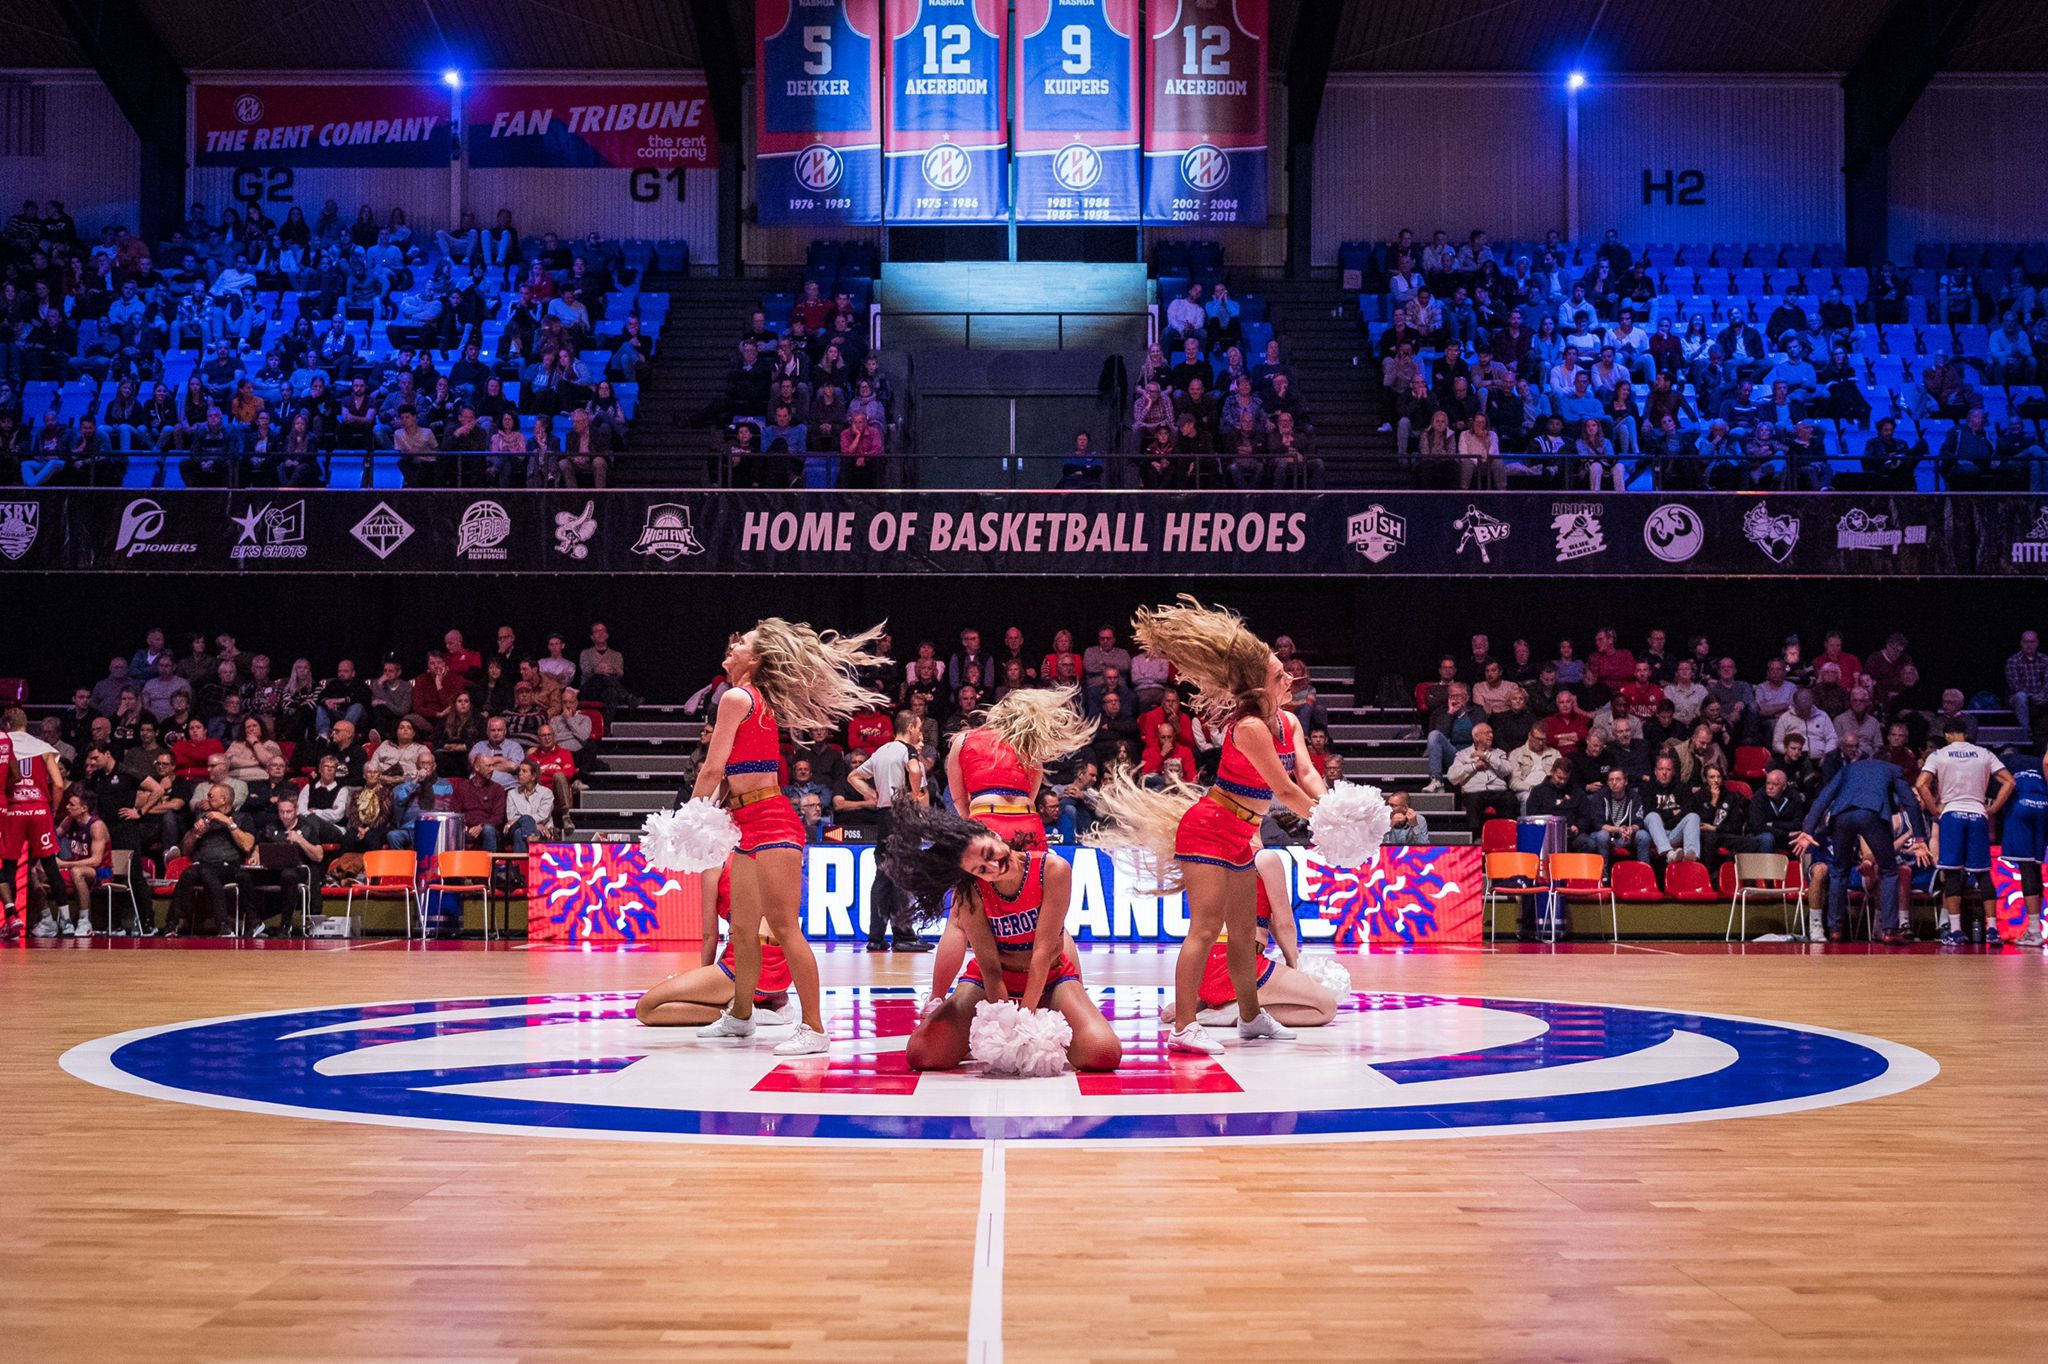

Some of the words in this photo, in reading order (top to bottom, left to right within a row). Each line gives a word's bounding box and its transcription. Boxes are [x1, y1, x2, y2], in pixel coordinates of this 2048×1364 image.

[804, 26, 832, 75] 5
[923, 24, 971, 74] 12
[1061, 24, 1091, 75] 9
[1182, 25, 1230, 75] 12
[786, 79, 850, 96] DEKKER
[905, 78, 988, 95] AKERBOOM
[1044, 79, 1109, 95] KUIPERS
[1164, 79, 1247, 96] AKERBOOM
[490, 109, 554, 138] FAN
[567, 98, 706, 133] TRIBUNE
[206, 130, 249, 152] THE
[253, 125, 314, 151] RENT
[318, 116, 439, 147] COMPANY
[648, 134, 673, 148] the
[676, 135, 707, 148] rent
[637, 147, 707, 162] company
[233, 167, 294, 203] G2
[630, 167, 686, 203] G1
[1643, 169, 1705, 205] H2
[789, 199, 814, 210] 1976
[825, 198, 851, 209] 1983
[916, 198, 941, 209] 1975
[953, 198, 979, 209] 1986
[1047, 197, 1072, 208] 1981
[1084, 197, 1110, 208] 1984
[1172, 199, 1200, 209] 2002
[1210, 199, 1238, 210] 2004
[1172, 210, 1200, 221] 2006
[1210, 211, 1236, 222] 2018
[361, 525, 404, 536] ALMONTE
[741, 511, 855, 552] HOME
[869, 511, 918, 552] OF
[930, 511, 1148, 553] BASKETBALL
[1163, 511, 1306, 553] HEROES
[1352, 516, 1401, 538] RUSH
[1474, 524, 1509, 544] BVS
[639, 528, 668, 546] HIGH
[670, 529, 697, 546] FIVE
[1569, 540, 1589, 550] BLUE
[263, 545, 307, 558] SHOTS
[1566, 545, 1597, 557] REBELS
[844, 830, 862, 839] POSS.
[988, 906, 1041, 937] HEROE
